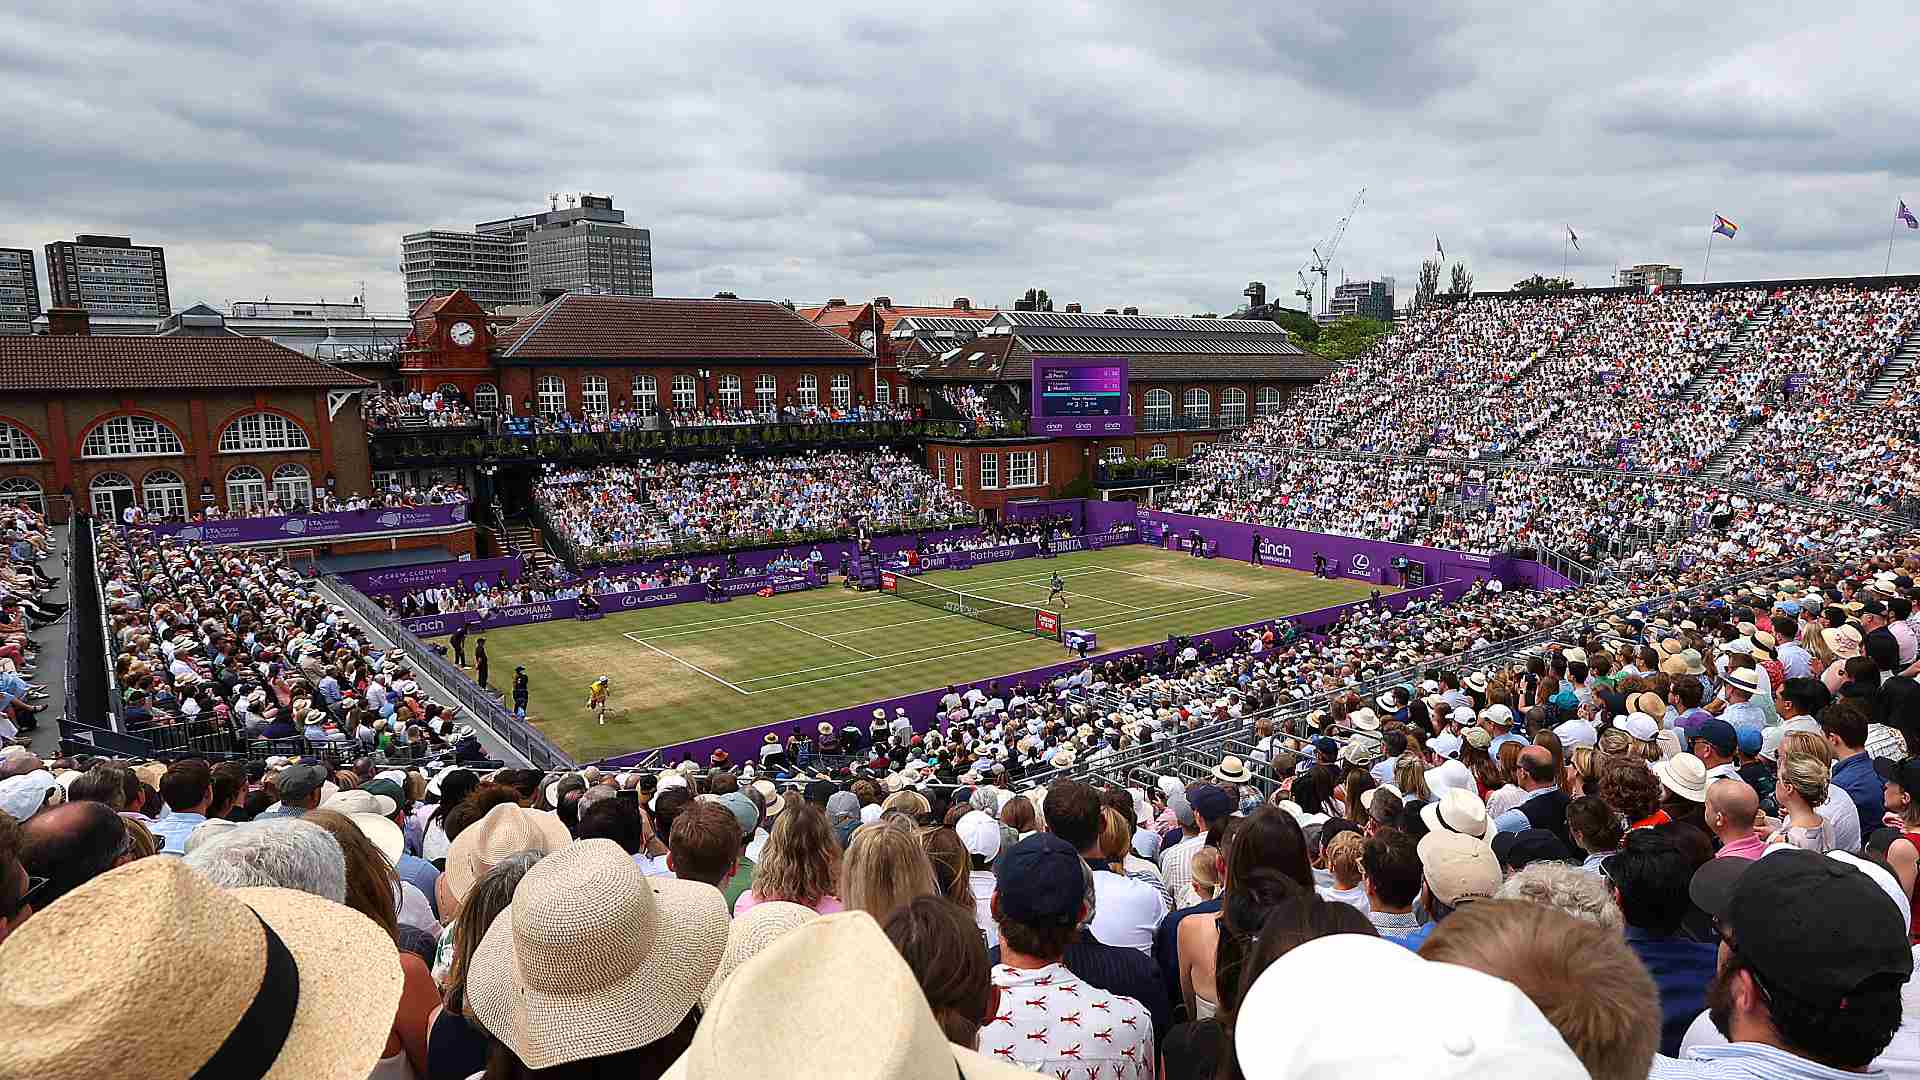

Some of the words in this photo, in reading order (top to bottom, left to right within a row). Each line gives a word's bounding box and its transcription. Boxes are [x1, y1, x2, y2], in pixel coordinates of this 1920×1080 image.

[1057, 539, 1082, 552] BRITA
[1259, 538, 1292, 558] cinch
[970, 549, 1015, 561] Rothesay
[637, 592, 678, 603] LEXUS
[503, 604, 553, 617] YOKOHAMA
[408, 618, 444, 633] cinch
